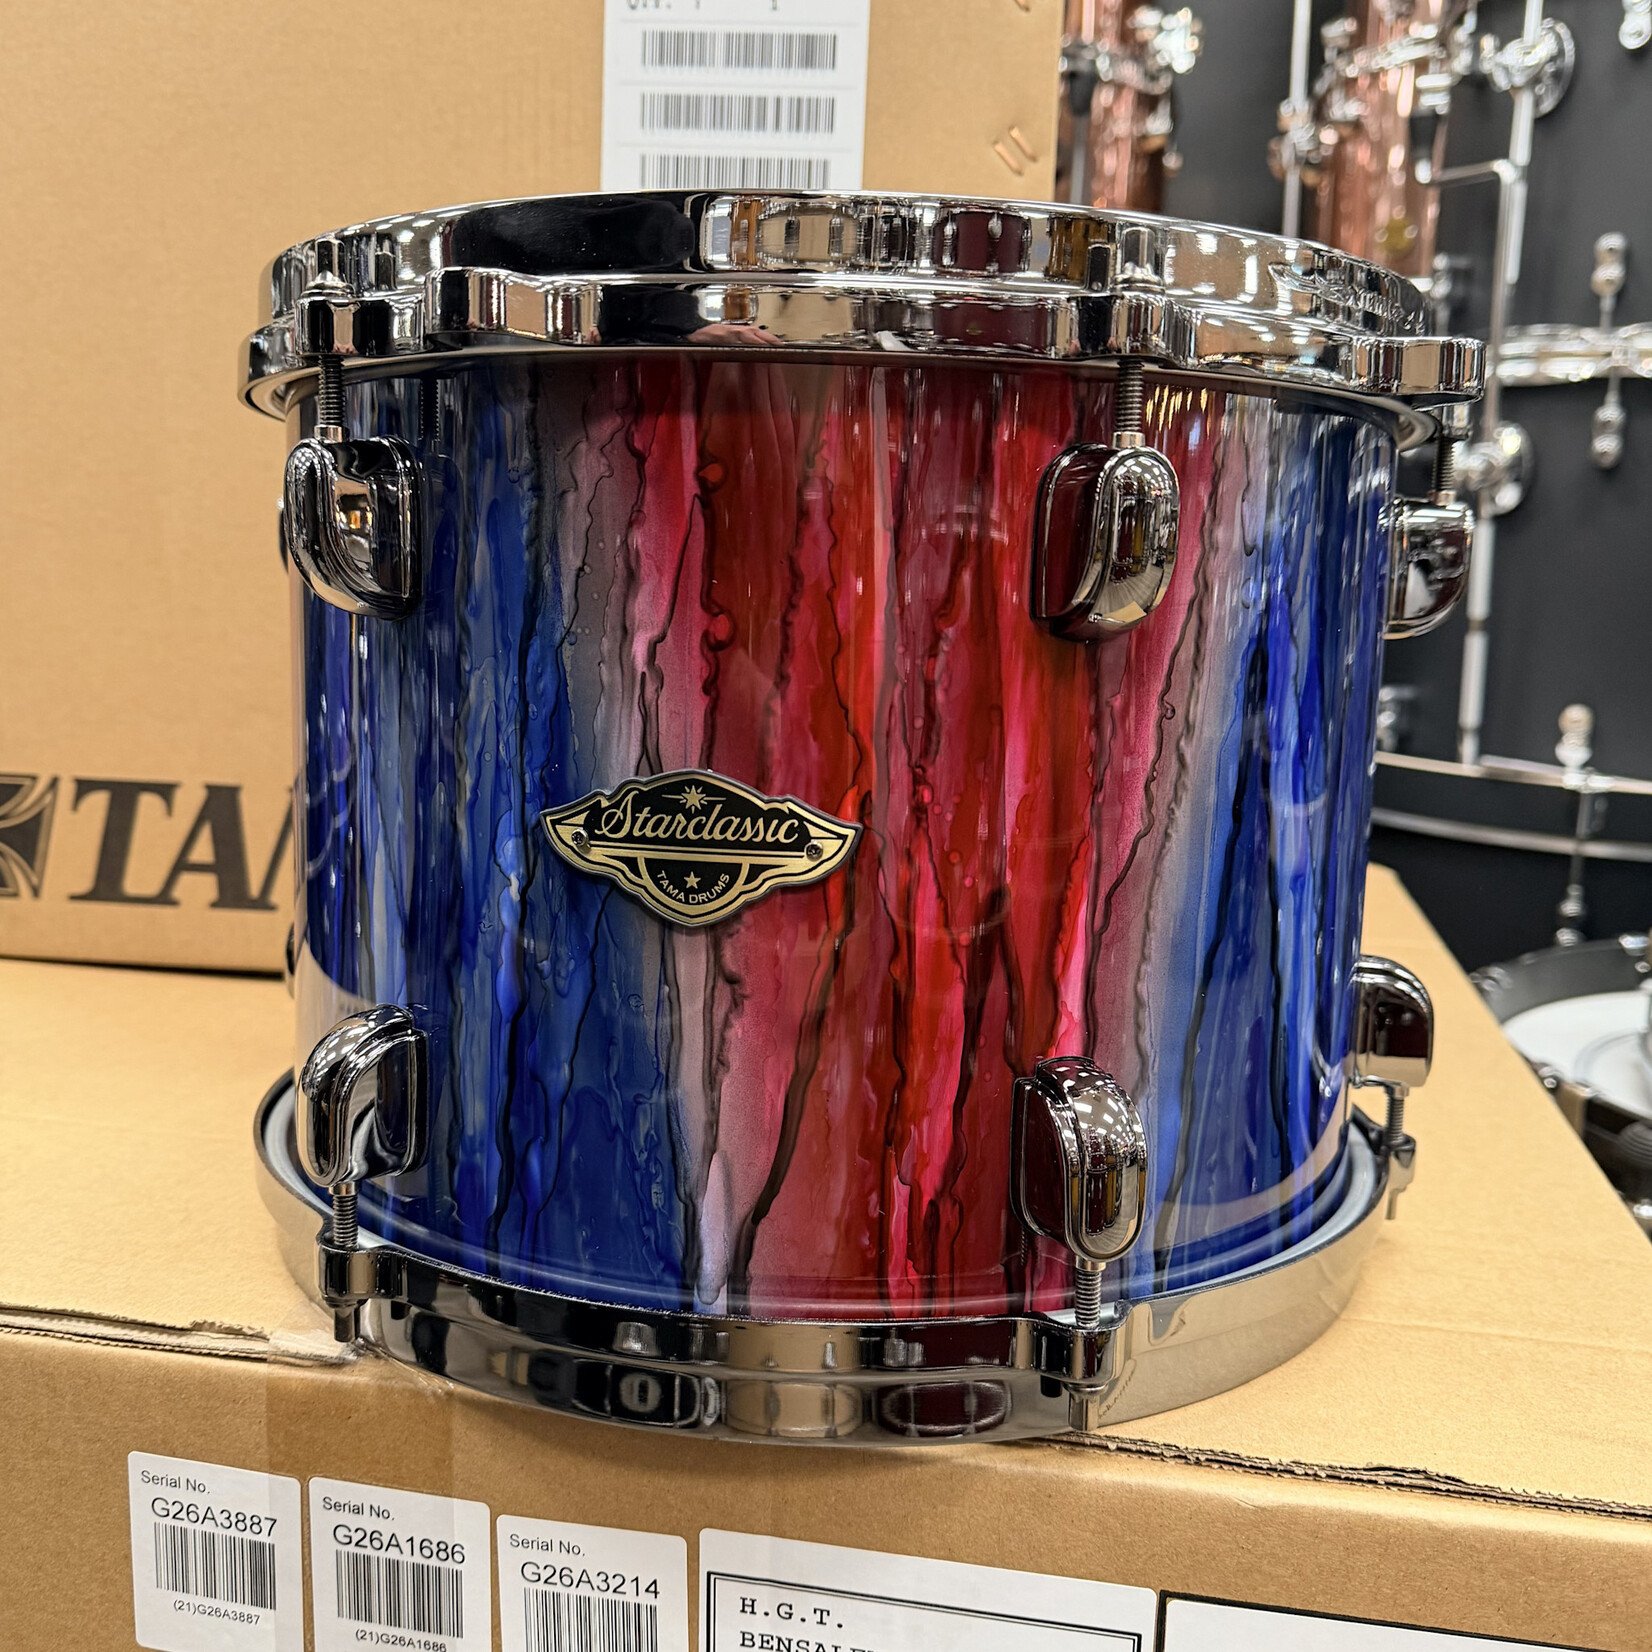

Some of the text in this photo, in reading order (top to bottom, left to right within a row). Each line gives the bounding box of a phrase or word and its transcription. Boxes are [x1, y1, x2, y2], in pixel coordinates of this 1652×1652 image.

[594, 790, 800, 844] Starclassic
[68, 777, 294, 911] TA
[657, 870, 730, 903] TAMA DRUMS
[141, 1470, 211, 1495] Serial No.
[151, 1497, 278, 1537] G26A3887
[323, 1496, 395, 1521] Serial No.
[333, 1524, 466, 1564] G26A1686
[509, 1533, 586, 1557] Serial No.
[520, 1561, 661, 1599] G26A3214
[173, 1599, 261, 1626] (21)G26A3887
[739, 1596, 844, 1628] H.G.T.
[355, 1628, 447, 1652] (21)G26A1686
[739, 1631, 875, 1652] BENSA
